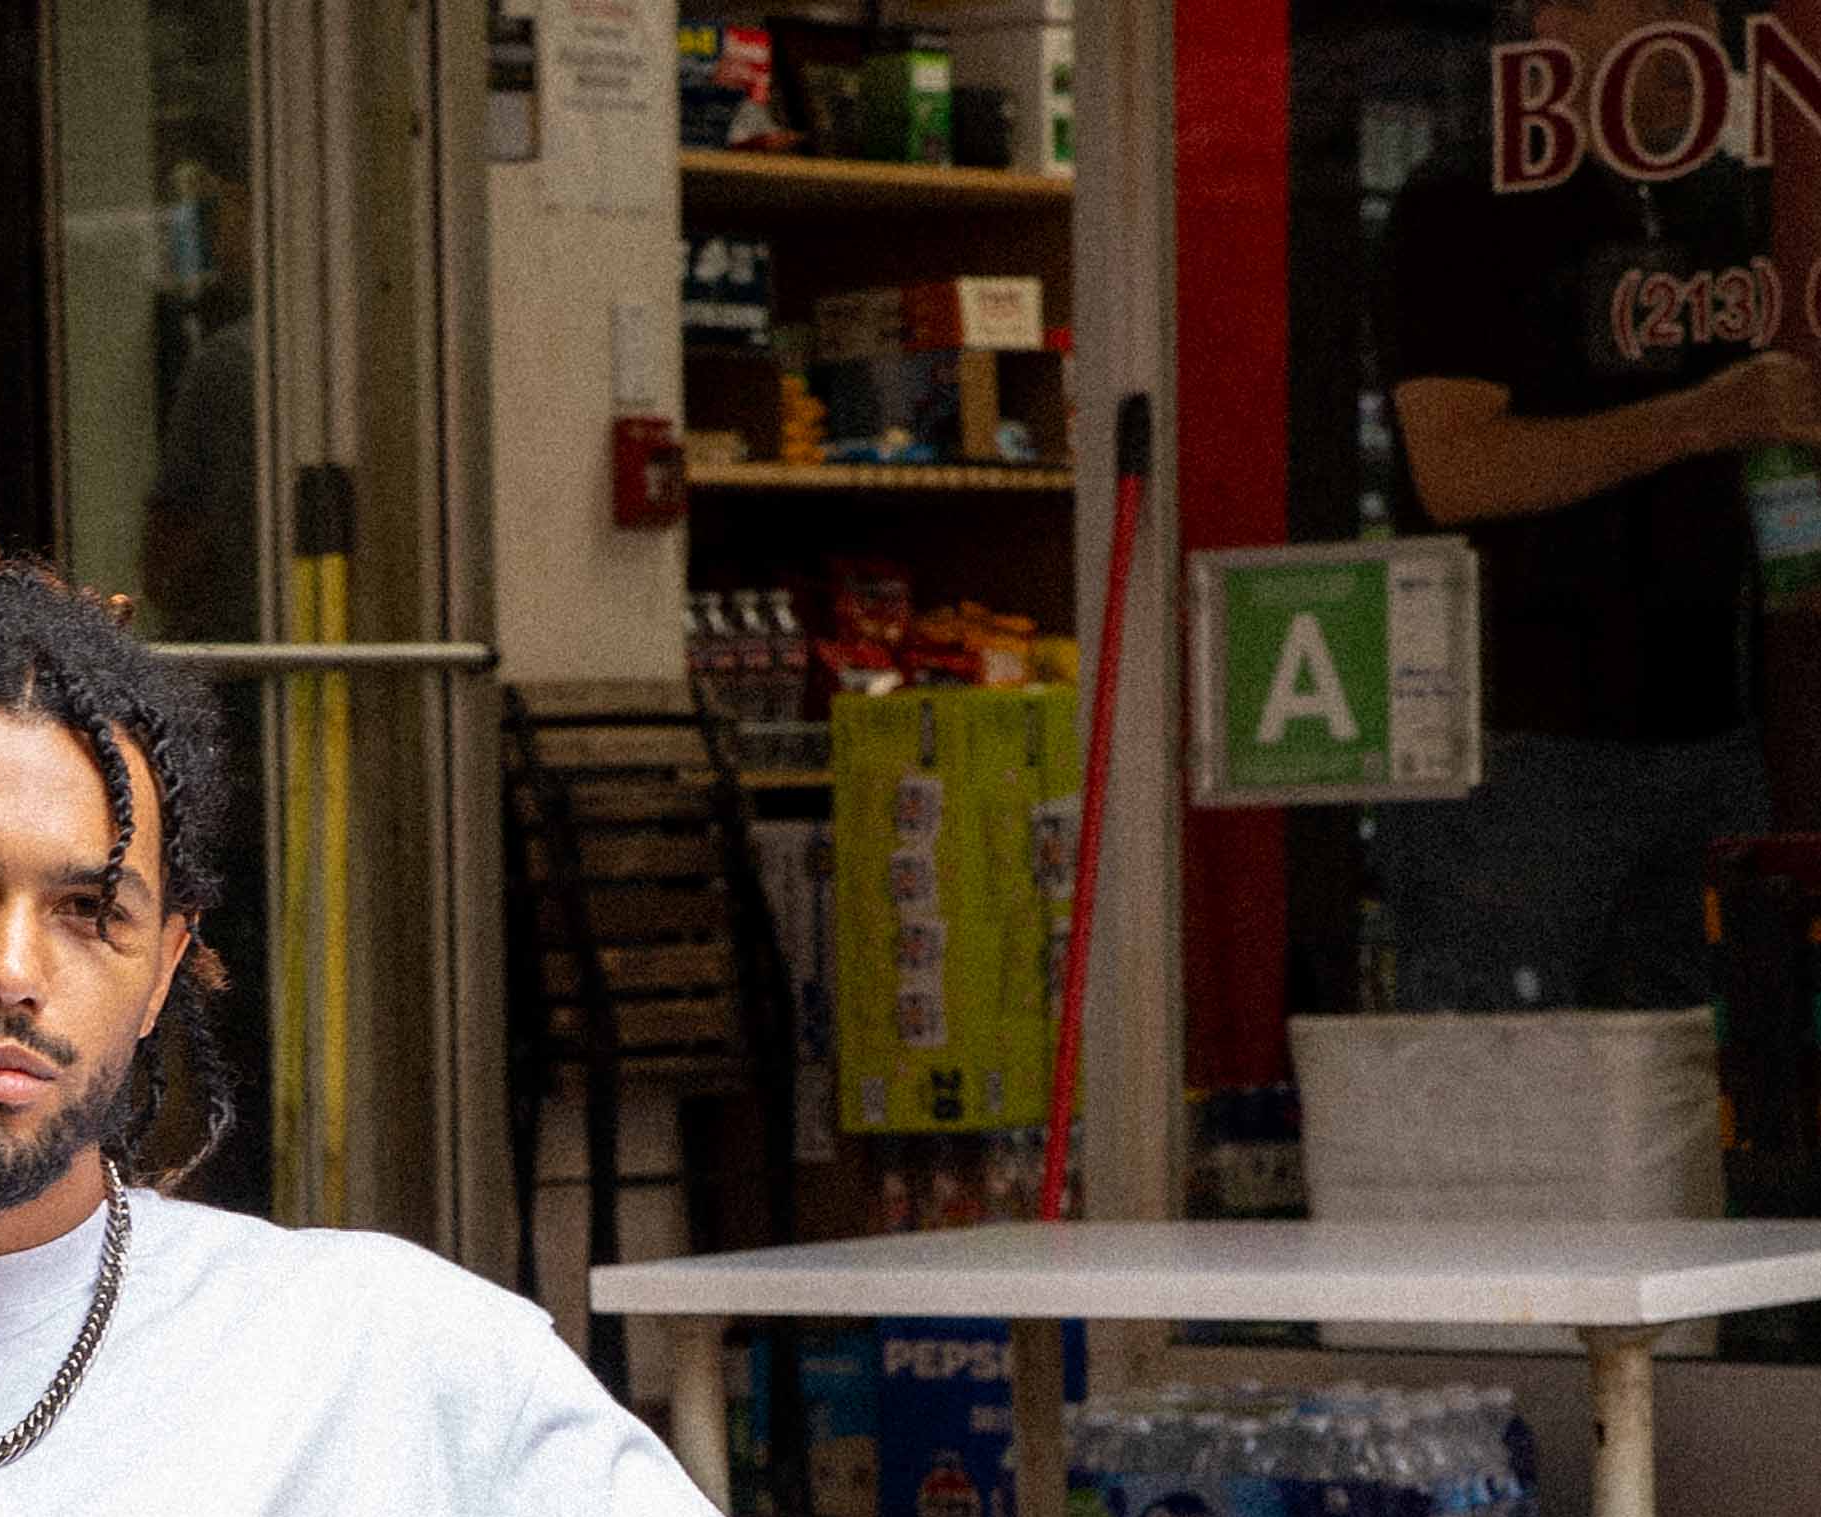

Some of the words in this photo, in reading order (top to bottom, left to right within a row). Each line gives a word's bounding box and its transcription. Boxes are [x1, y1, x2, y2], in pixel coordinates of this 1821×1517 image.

[1491, 13, 1821, 194] BON
[1611, 257, 1781, 360] (213)
[1256, 612, 1360, 745] A
